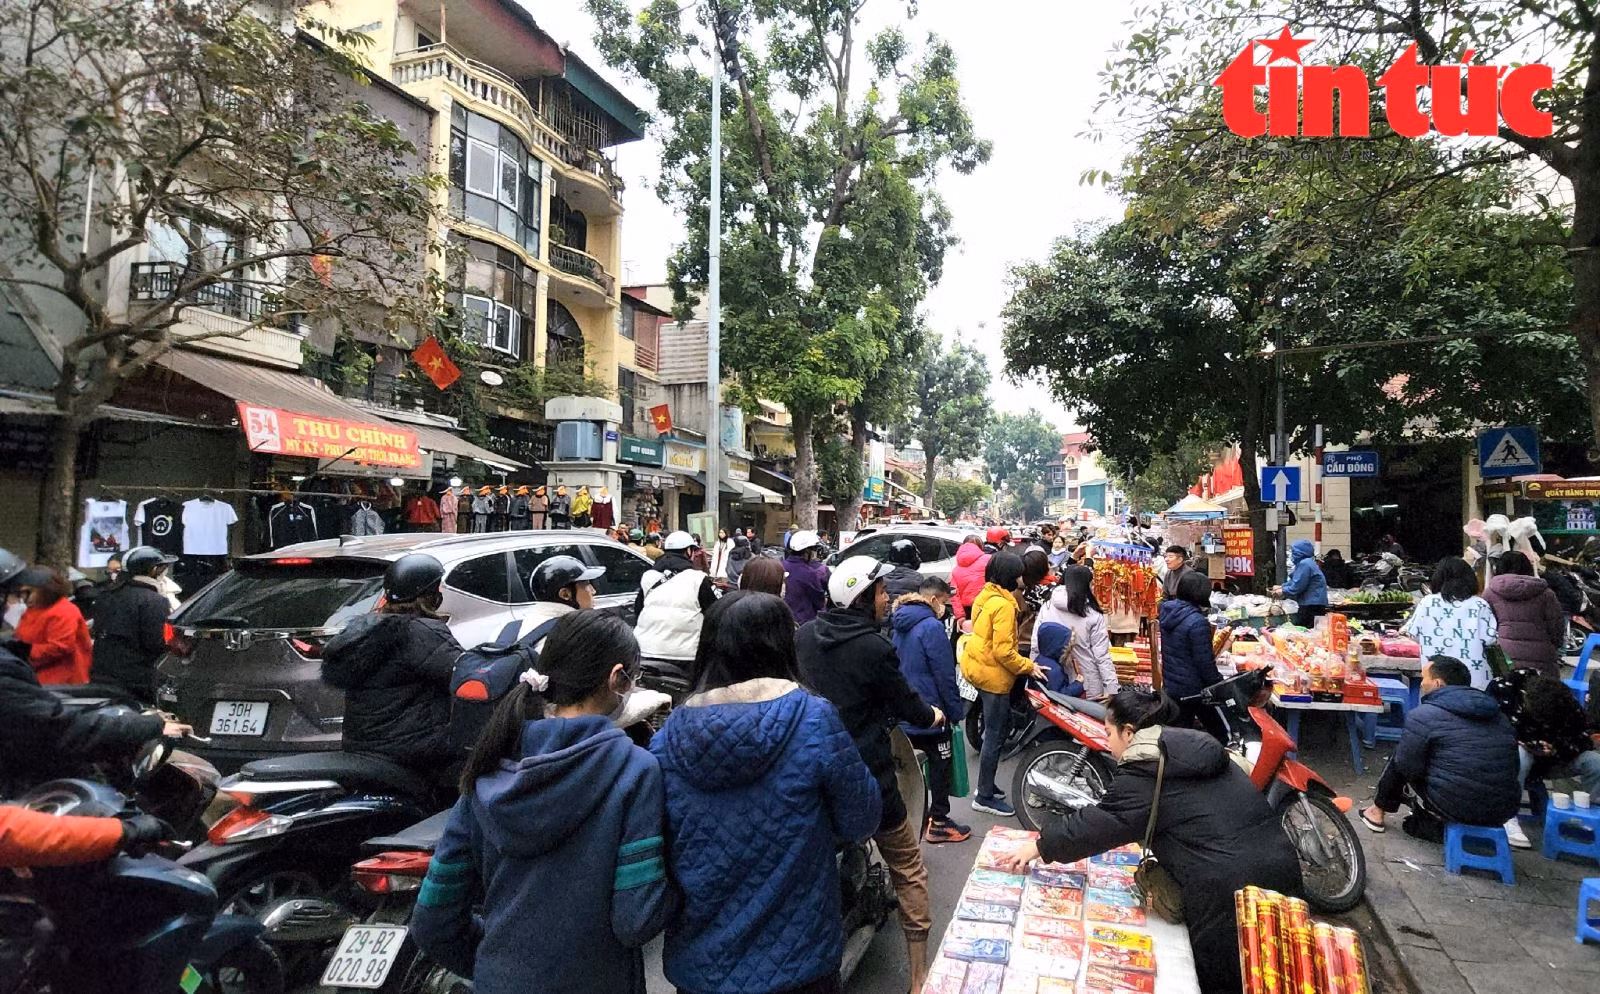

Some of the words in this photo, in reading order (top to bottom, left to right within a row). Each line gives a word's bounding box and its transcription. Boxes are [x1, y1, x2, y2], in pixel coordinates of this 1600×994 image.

[292, 417, 340, 439] THU
[228, 703, 253, 717] 30H
[215, 718, 258, 733] 361.64
[327, 957, 387, 983] 020.98
